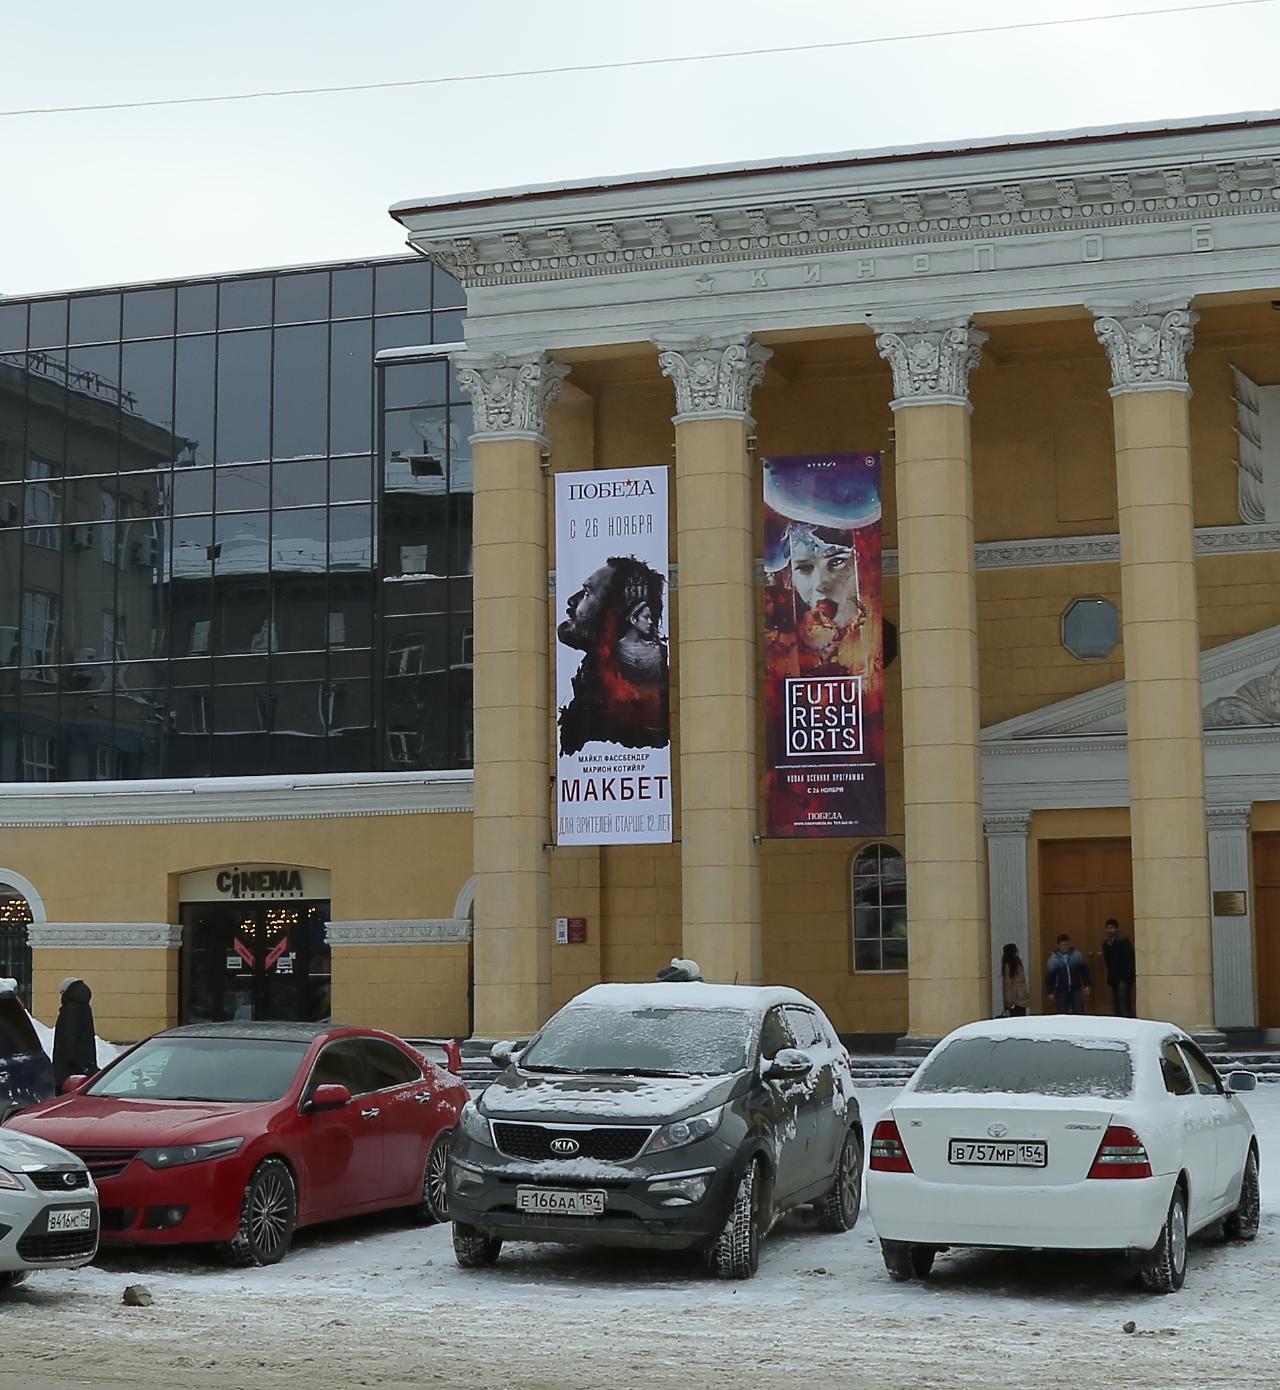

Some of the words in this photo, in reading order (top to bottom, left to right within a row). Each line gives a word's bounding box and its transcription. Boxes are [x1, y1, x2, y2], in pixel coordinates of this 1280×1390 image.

[750, 254, 930, 287] КИНО
[568, 479, 656, 500] ПОБЕДА
[570, 519, 576, 538] С
[585, 518, 599, 538] 26
[608, 514, 652, 536] НОЯБРЯ
[792, 682, 856, 705] FUTU
[792, 705, 856, 728] RESH
[792, 728, 856, 750] ORTS
[604, 754, 650, 762] ФАССБЕНДЕР
[613, 764, 646, 772] КОТИЙЯР
[562, 776, 668, 802] МАКБЕТ
[559, 816, 574, 835] ДЛЯ
[576, 813, 613, 834] ЗРИТЕЛЕЙ
[615, 814, 645, 832] СТАРШЕ
[647, 815, 654, 832] 12
[657, 814, 671, 832] ЛЕТ
[554, 1142, 574, 1150] KIA
[1019, 1146, 1041, 1158] 154
[580, 1194, 600, 1206] 154
